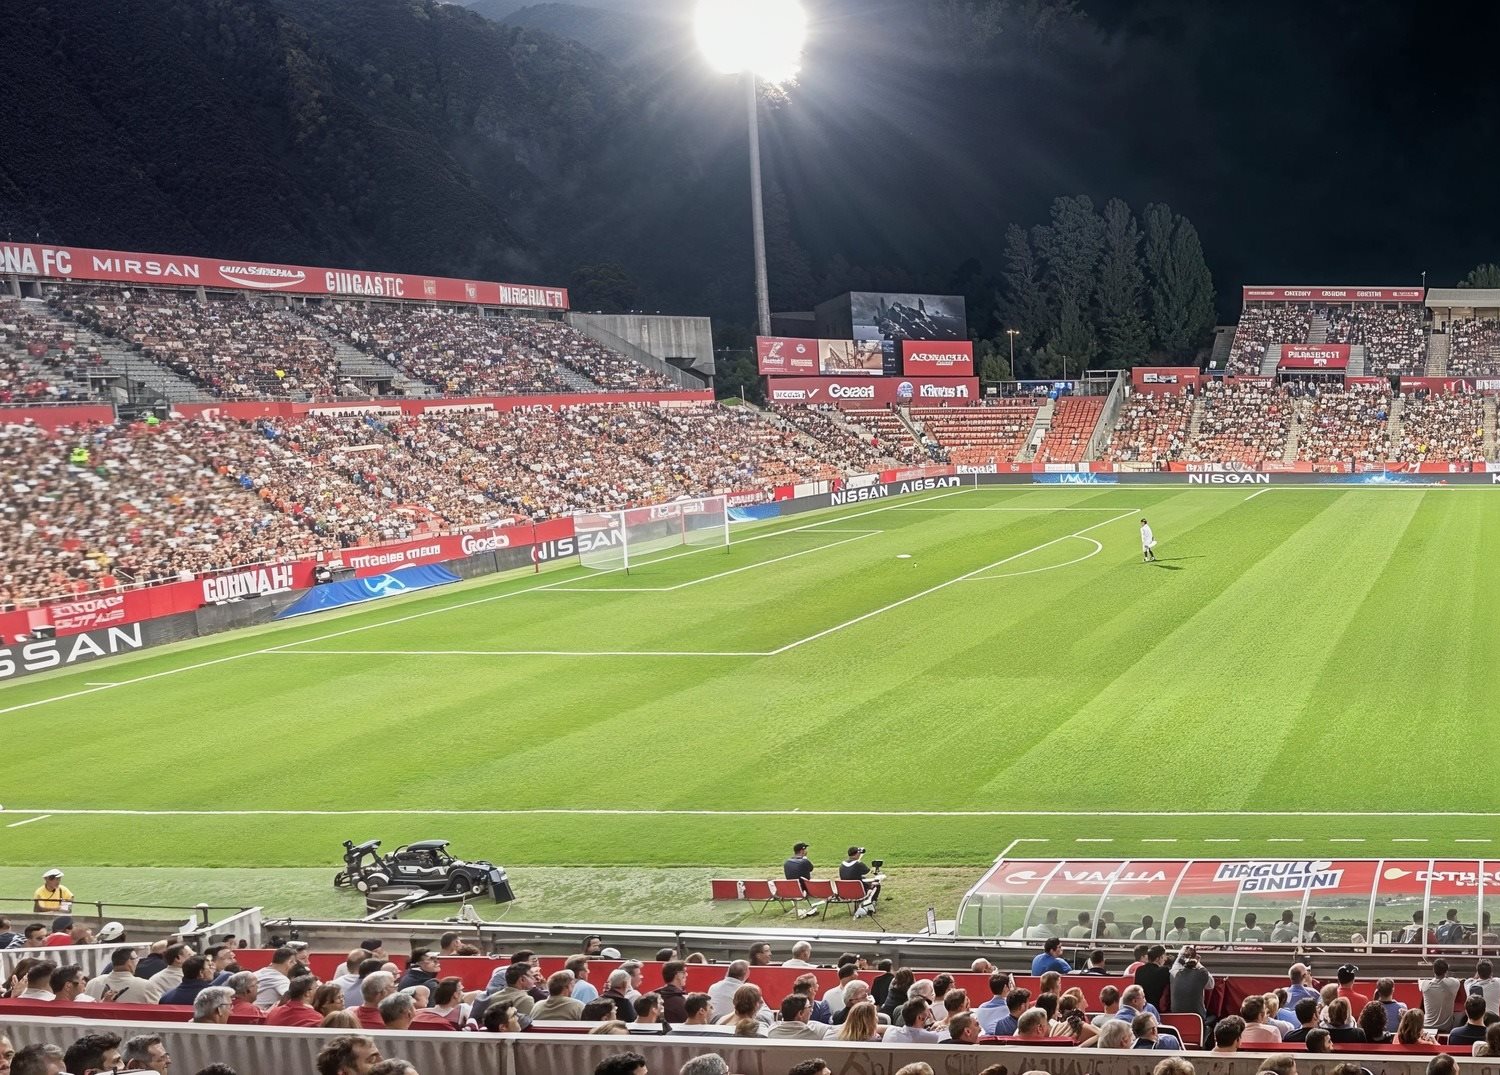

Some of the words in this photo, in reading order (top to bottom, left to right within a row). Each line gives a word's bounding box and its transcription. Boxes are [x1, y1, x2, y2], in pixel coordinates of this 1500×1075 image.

[0, 246, 40, 274] NA
[42, 249, 72, 275] FC
[92, 256, 200, 278] MIRSAN
